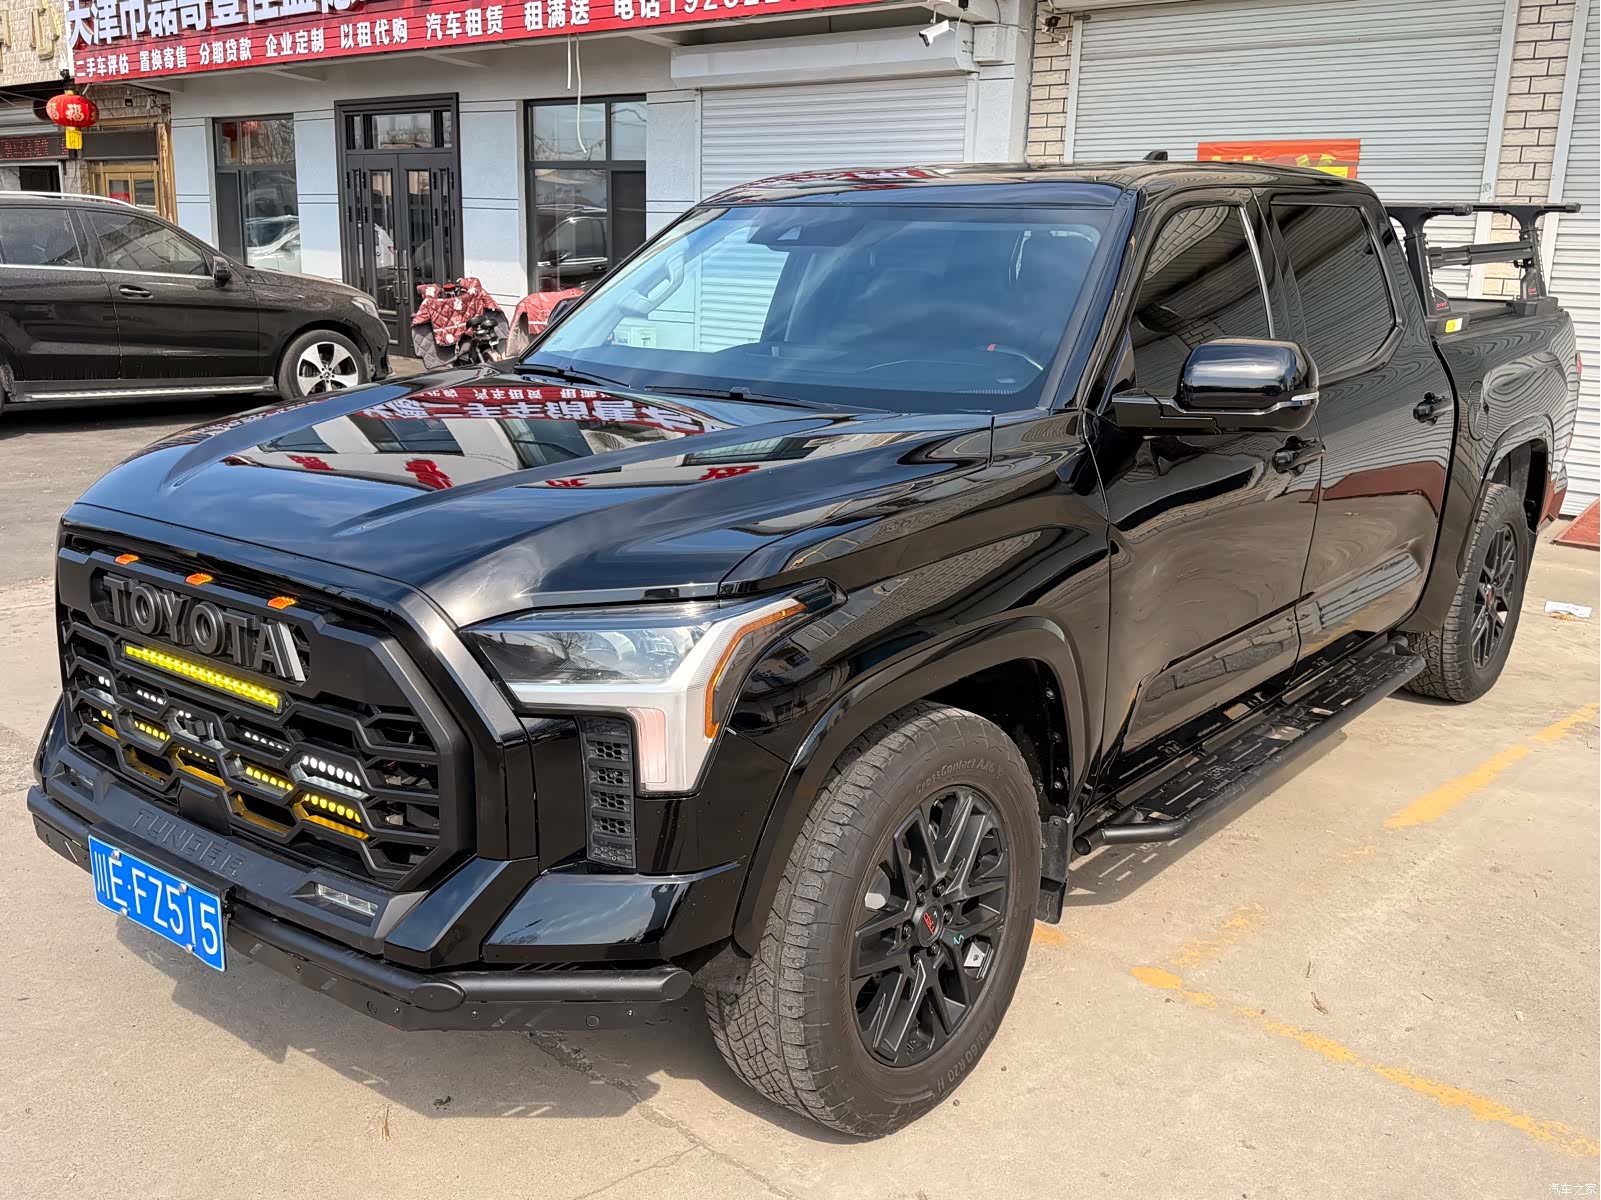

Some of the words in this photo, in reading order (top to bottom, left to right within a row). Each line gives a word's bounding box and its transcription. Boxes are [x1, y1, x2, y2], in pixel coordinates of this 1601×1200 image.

[76, 53, 129, 77] 二手车评估
[140, 45, 187, 72] 置换寄售
[199, 37, 252, 65] 分期贷款
[265, 27, 325, 57] 企业定制
[340, 17, 408, 49] 以租代购
[426, 5, 503, 40] 汽车租赁
[524, 0, 590, 31] 租满送
[102, 572, 306, 683] TOYOTA
